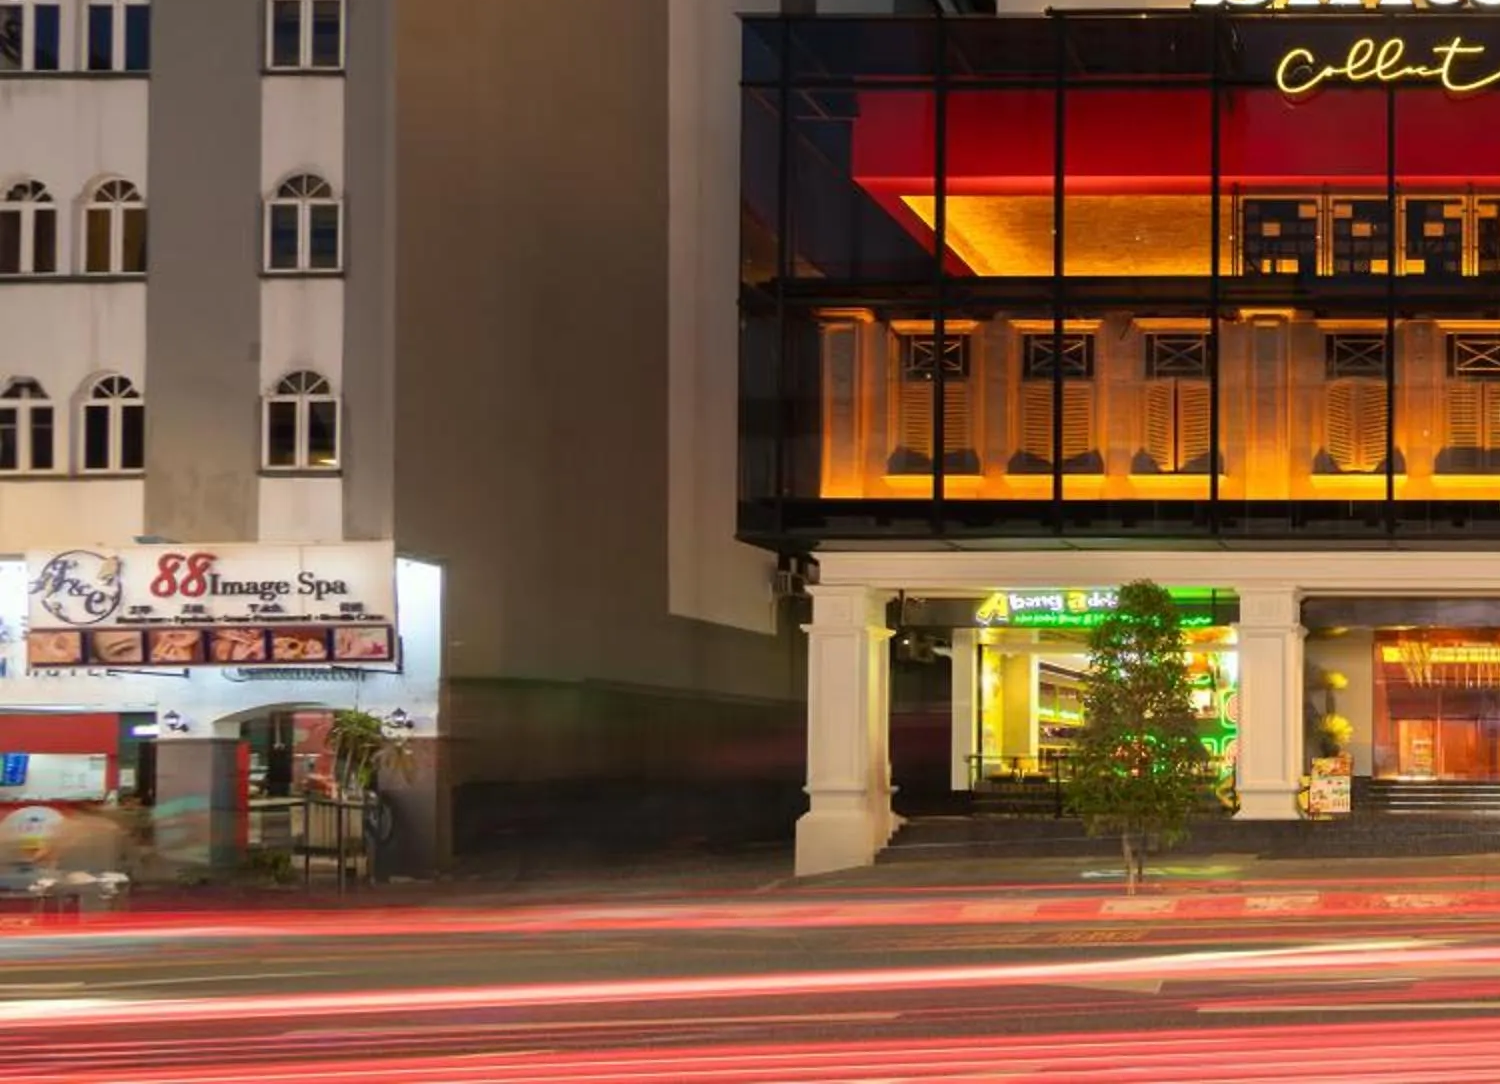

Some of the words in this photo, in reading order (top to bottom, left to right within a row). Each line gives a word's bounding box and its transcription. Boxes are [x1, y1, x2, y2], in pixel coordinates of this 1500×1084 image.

[150, 553, 217, 598] 88
[209, 573, 290, 600] Image
[297, 572, 347, 599] Spa
